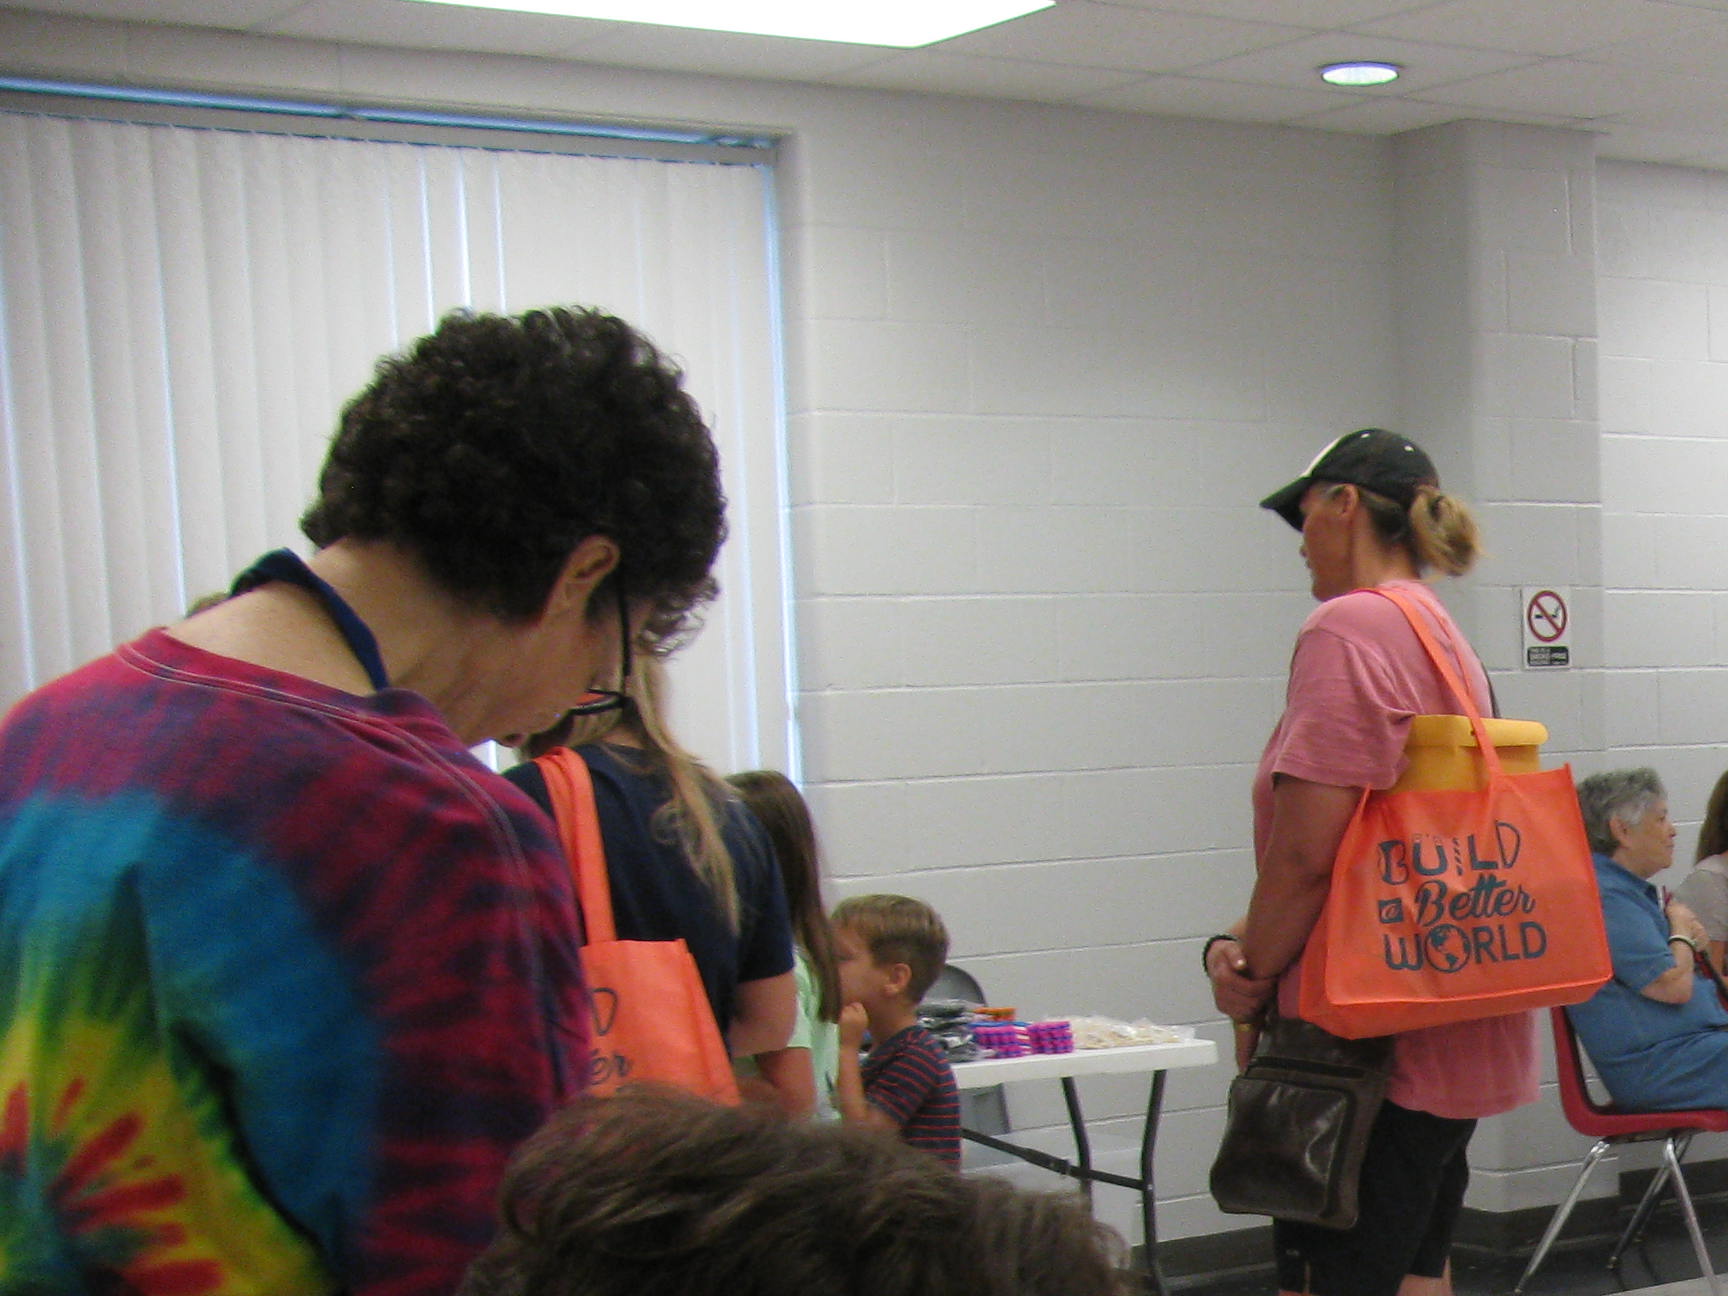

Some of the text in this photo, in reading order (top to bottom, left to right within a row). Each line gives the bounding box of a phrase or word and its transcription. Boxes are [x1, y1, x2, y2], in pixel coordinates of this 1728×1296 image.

[1377, 820, 1521, 886] BUILD
[1414, 873, 1536, 927] Better
[1383, 921, 1548, 974] WORLD
